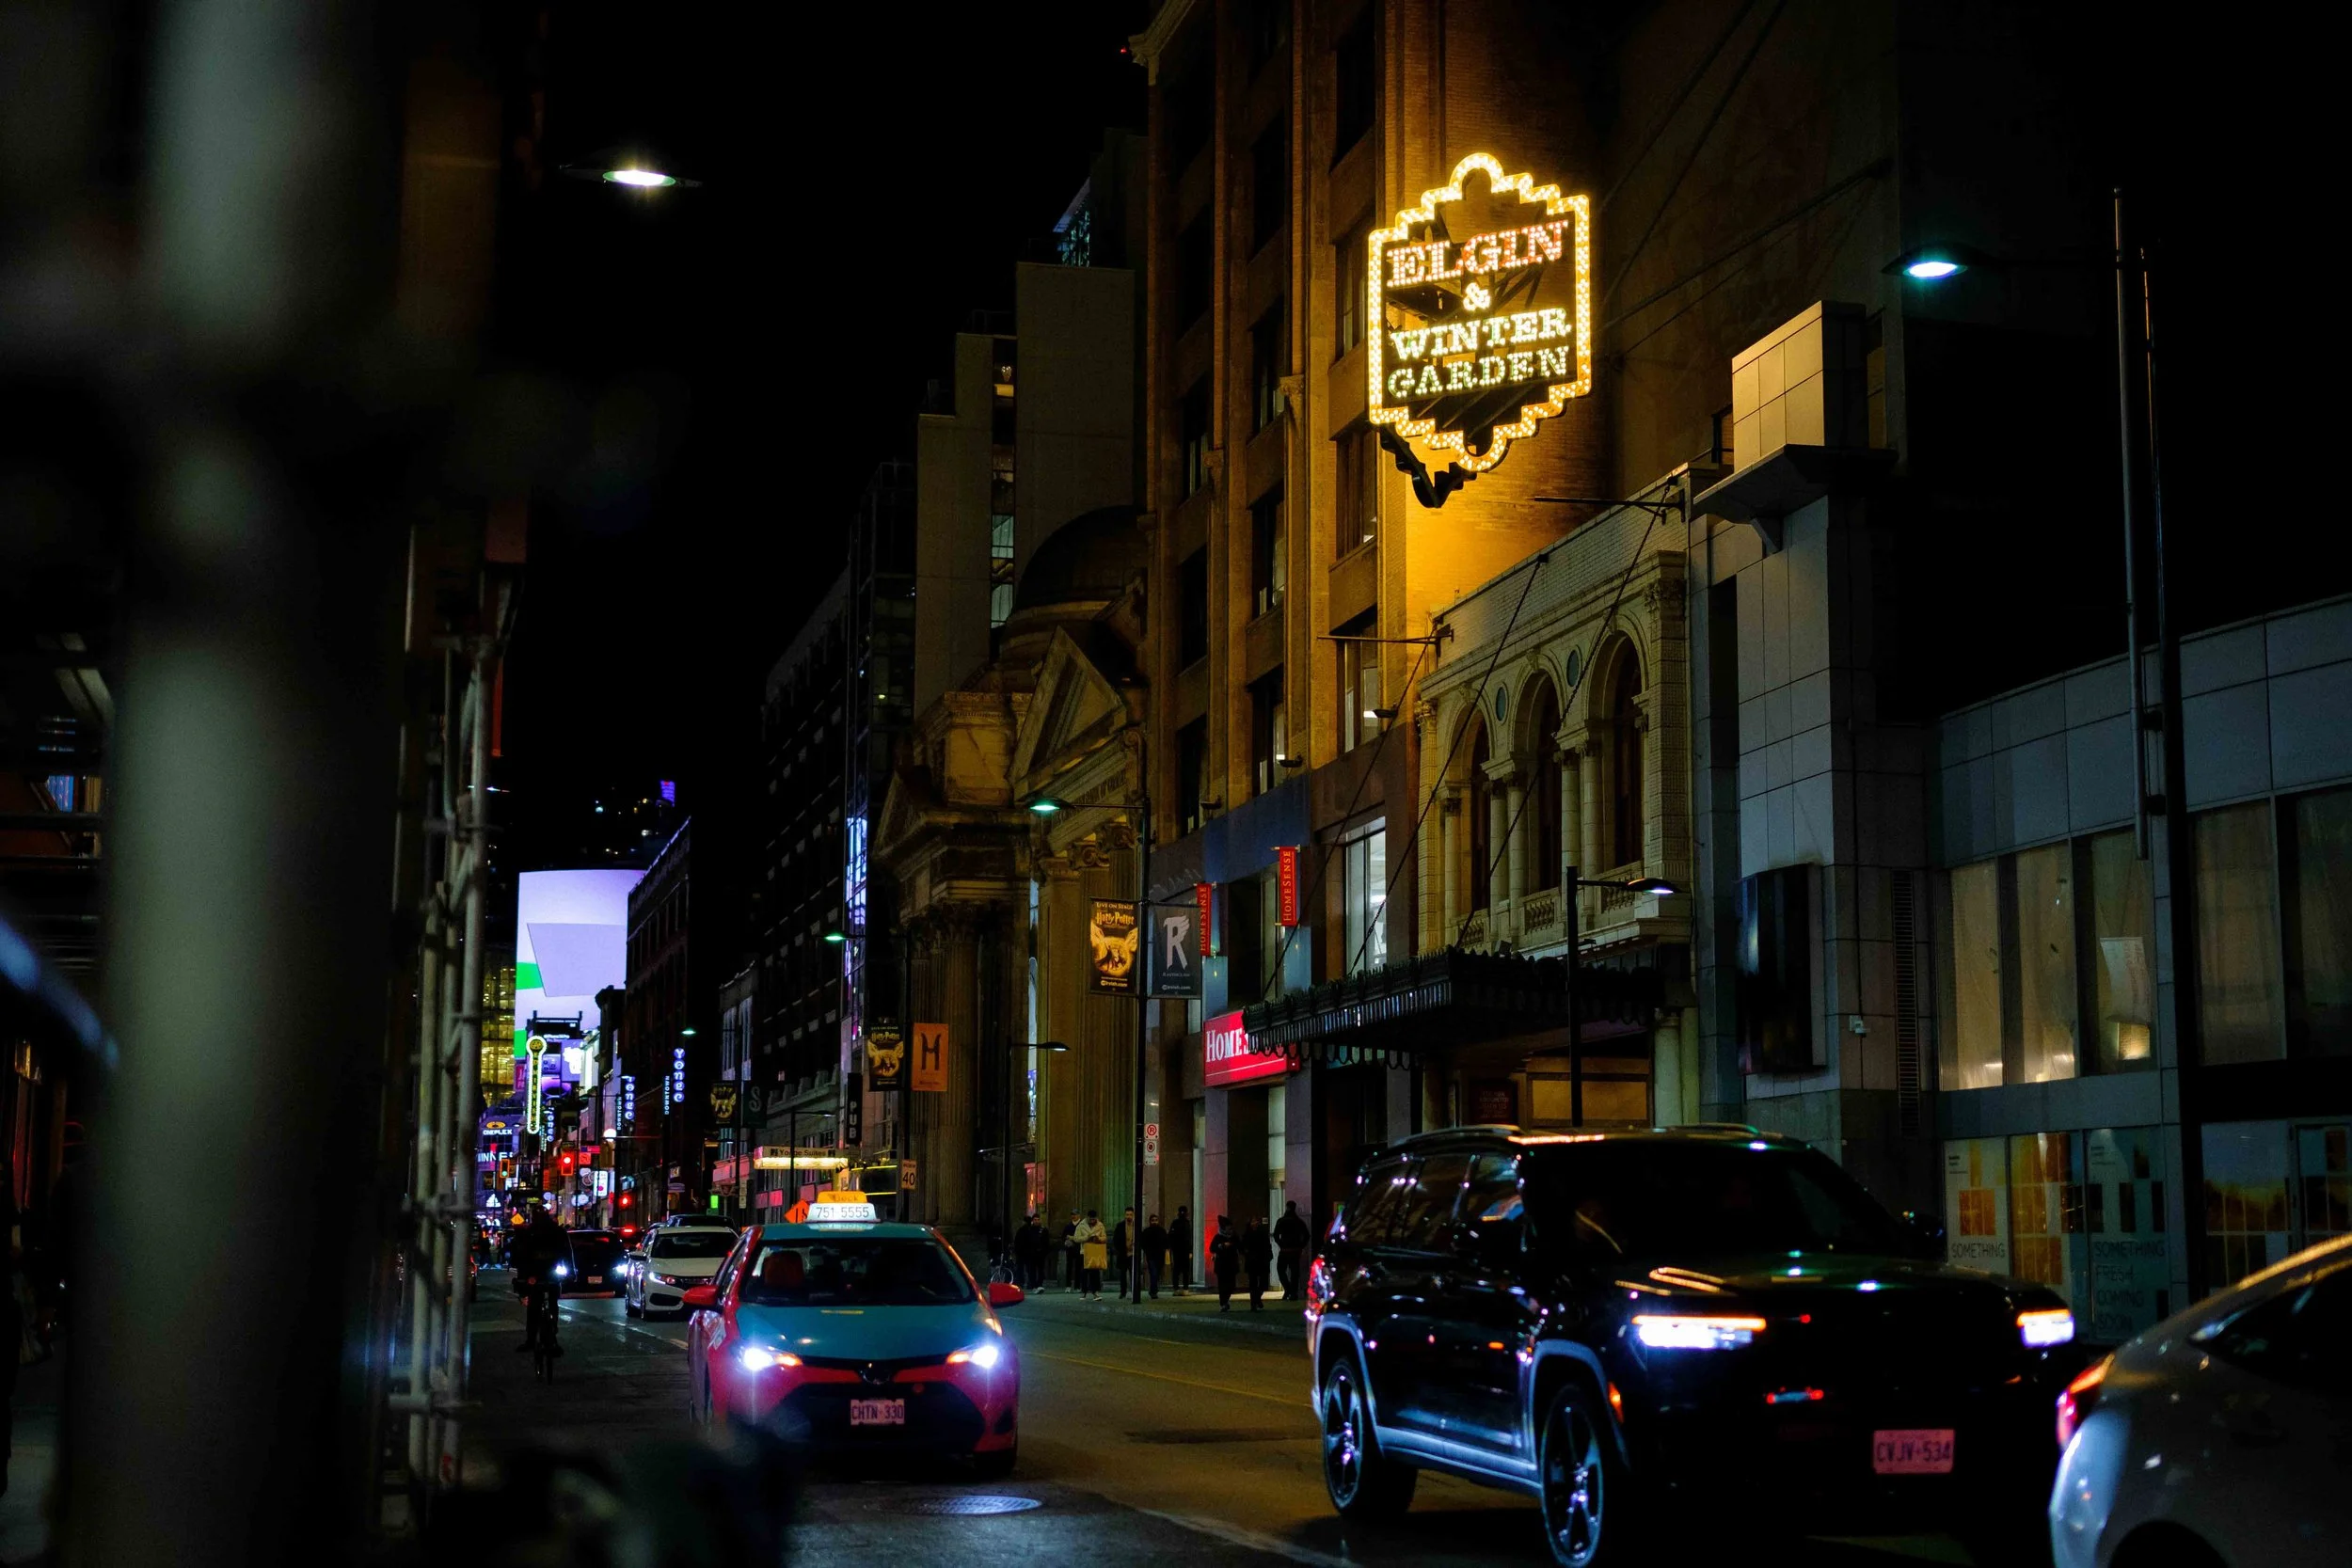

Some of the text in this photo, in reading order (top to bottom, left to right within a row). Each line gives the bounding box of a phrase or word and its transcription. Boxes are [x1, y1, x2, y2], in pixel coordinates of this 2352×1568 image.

[1387, 220, 1568, 287] ELGIN
[1463, 282, 1491, 311] &
[1391, 308, 1572, 360] WINTER
[1388, 346, 1569, 398] GARDEN
[849, 1101, 858, 1139] PUB
[902, 1172, 915, 1185] 40
[1951, 1243, 2006, 1259] SOMETHING
[2094, 1241, 2165, 1258] SOMETHING
